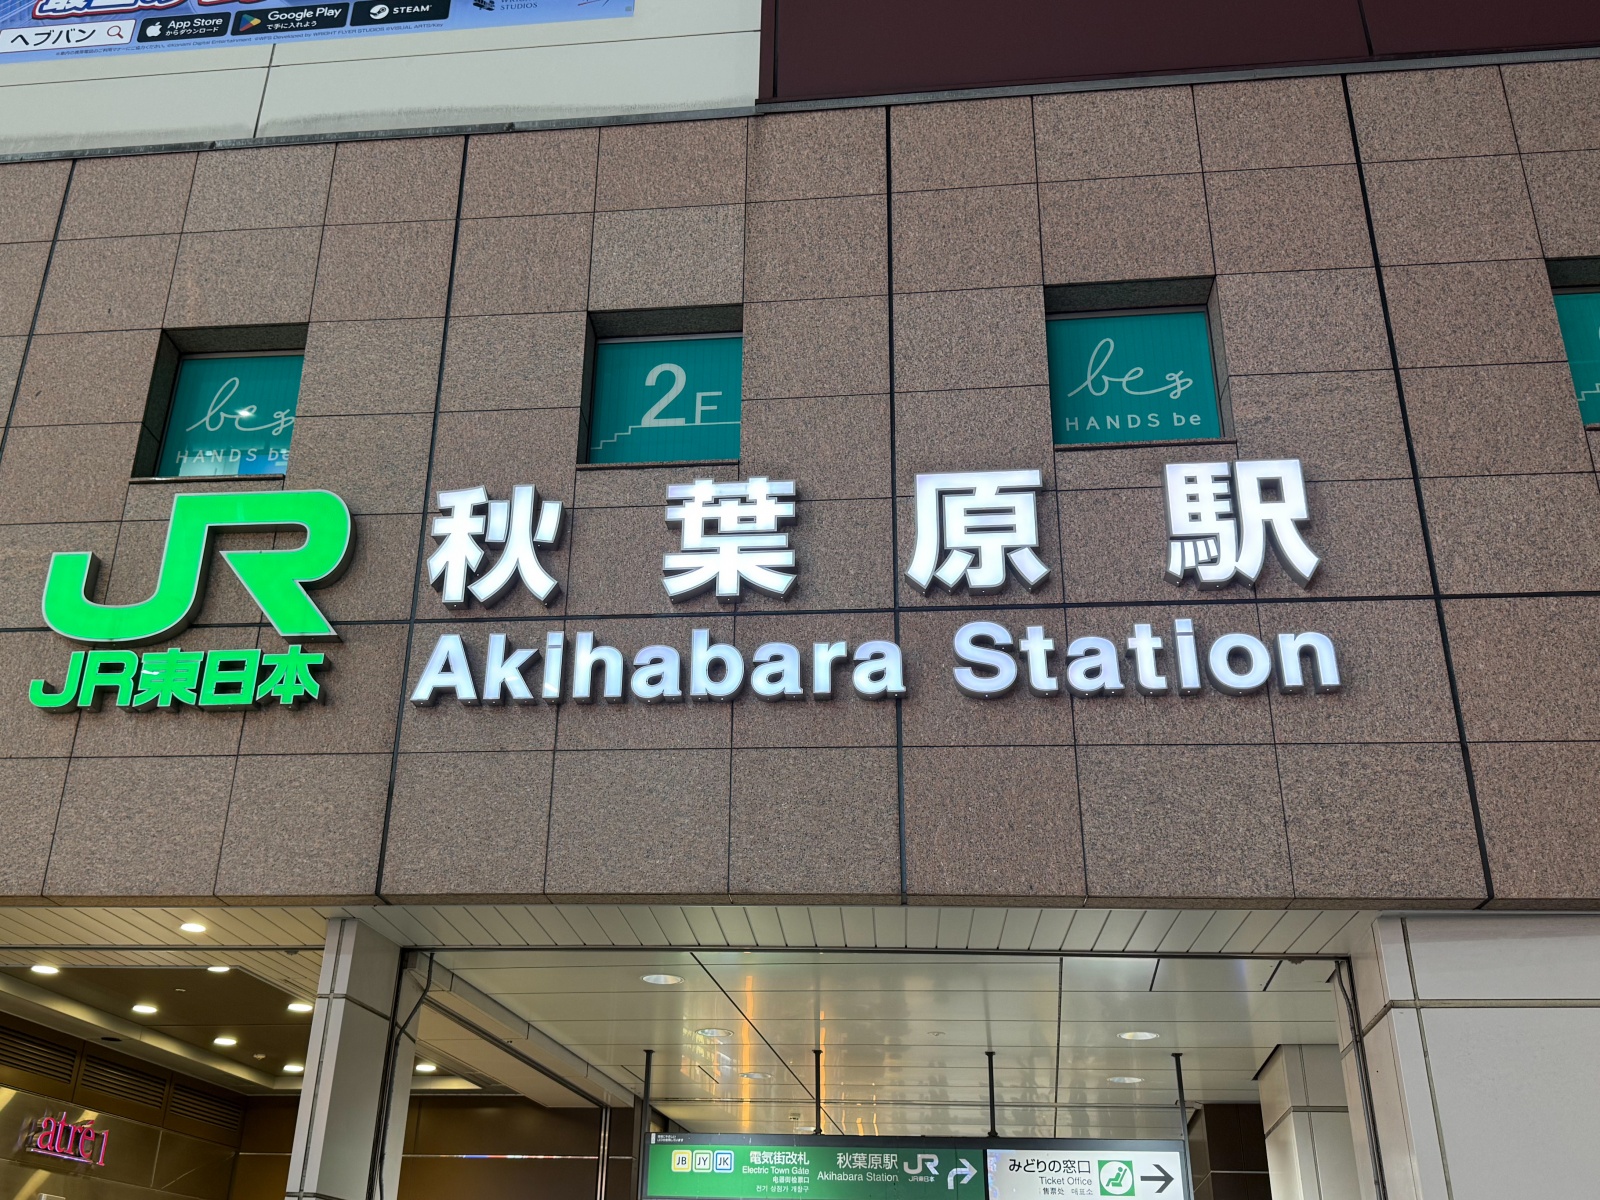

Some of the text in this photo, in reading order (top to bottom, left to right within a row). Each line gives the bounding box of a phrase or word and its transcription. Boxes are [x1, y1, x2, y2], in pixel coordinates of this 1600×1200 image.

[268, 7, 343, 21] Google Play
[392, 5, 430, 15] STEAM
[500, 3, 538, 11] STUDIOS
[165, 26, 220, 36] からダウンロード
[167, 17, 223, 31] App Store
[266, 20, 317, 30] で手に入れよう
[10, 28, 97, 46] ヘブバン
[641, 363, 723, 427] 2F
[1065, 412, 1202, 431] HANDS be
[175, 448, 258, 465] HANDS
[427, 459, 1321, 605] 秋葉原駅
[42, 489, 351, 643] JR
[410, 618, 1342, 706] Akihabara Station
[29, 645, 326, 709] JR東日本
[37, 1112, 96, 1160] atré
[676, 1156, 729, 1166] JB JY JK
[749, 1151, 810, 1165] 電気街改札
[836, 1152, 899, 1170] 秋葉原駅
[903, 1154, 940, 1175] JR
[1008, 1158, 1091, 1174] みどりの窓口
[742, 1166, 810, 1175] Electric Town Gate
[817, 1171, 899, 1182] Akihabara Station
[1039, 1176, 1093, 1186] Ticket Office
